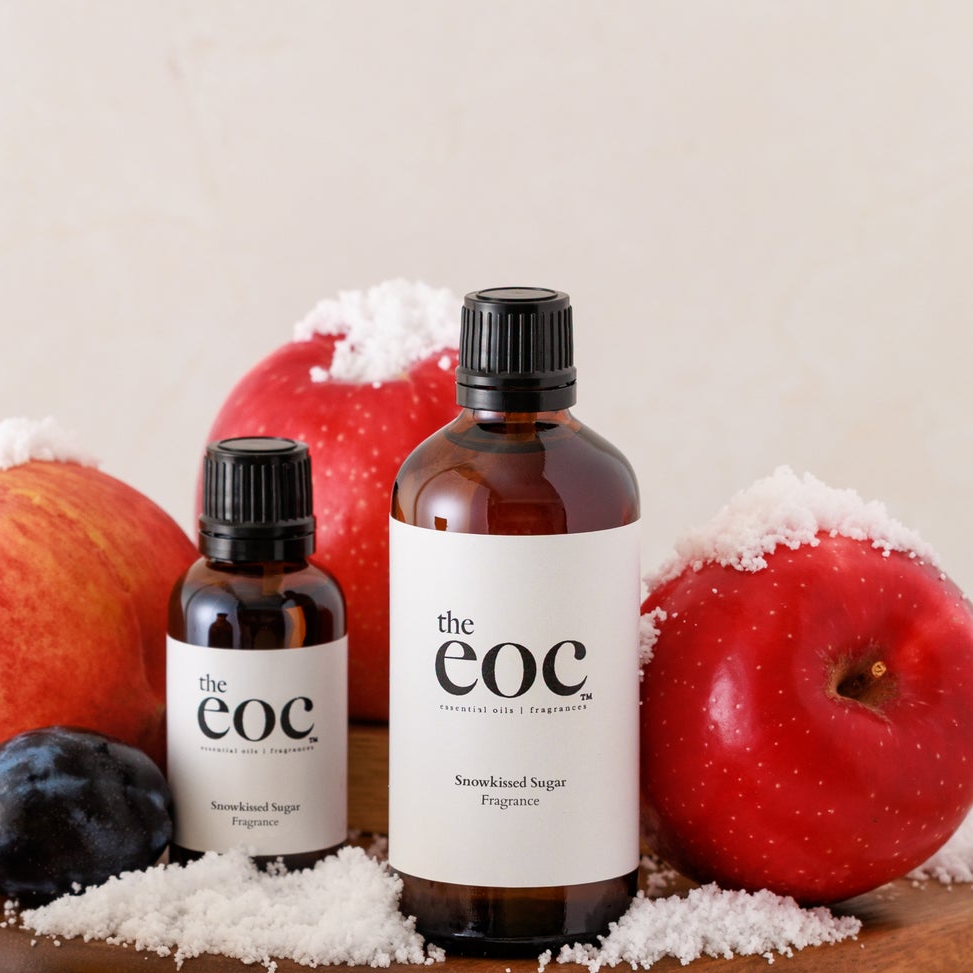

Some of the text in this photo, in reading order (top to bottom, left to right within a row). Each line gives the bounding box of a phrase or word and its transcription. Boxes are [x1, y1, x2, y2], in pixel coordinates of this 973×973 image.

[438, 610, 474, 635] the
[435, 640, 587, 698] eoc
[200, 674, 227, 693] the
[439, 704, 487, 714] essential
[492, 706, 514, 714] oils
[530, 704, 587, 715] fragrances
[198, 696, 315, 742] eoc
[270, 745, 315, 755] fragrances
[455, 775, 566, 791] Snowkissed Sugar
[211, 801, 300, 814] Snowkissed Sugar
[482, 795, 539, 809] Fragrance
[232, 817, 279, 829] Fragrance
